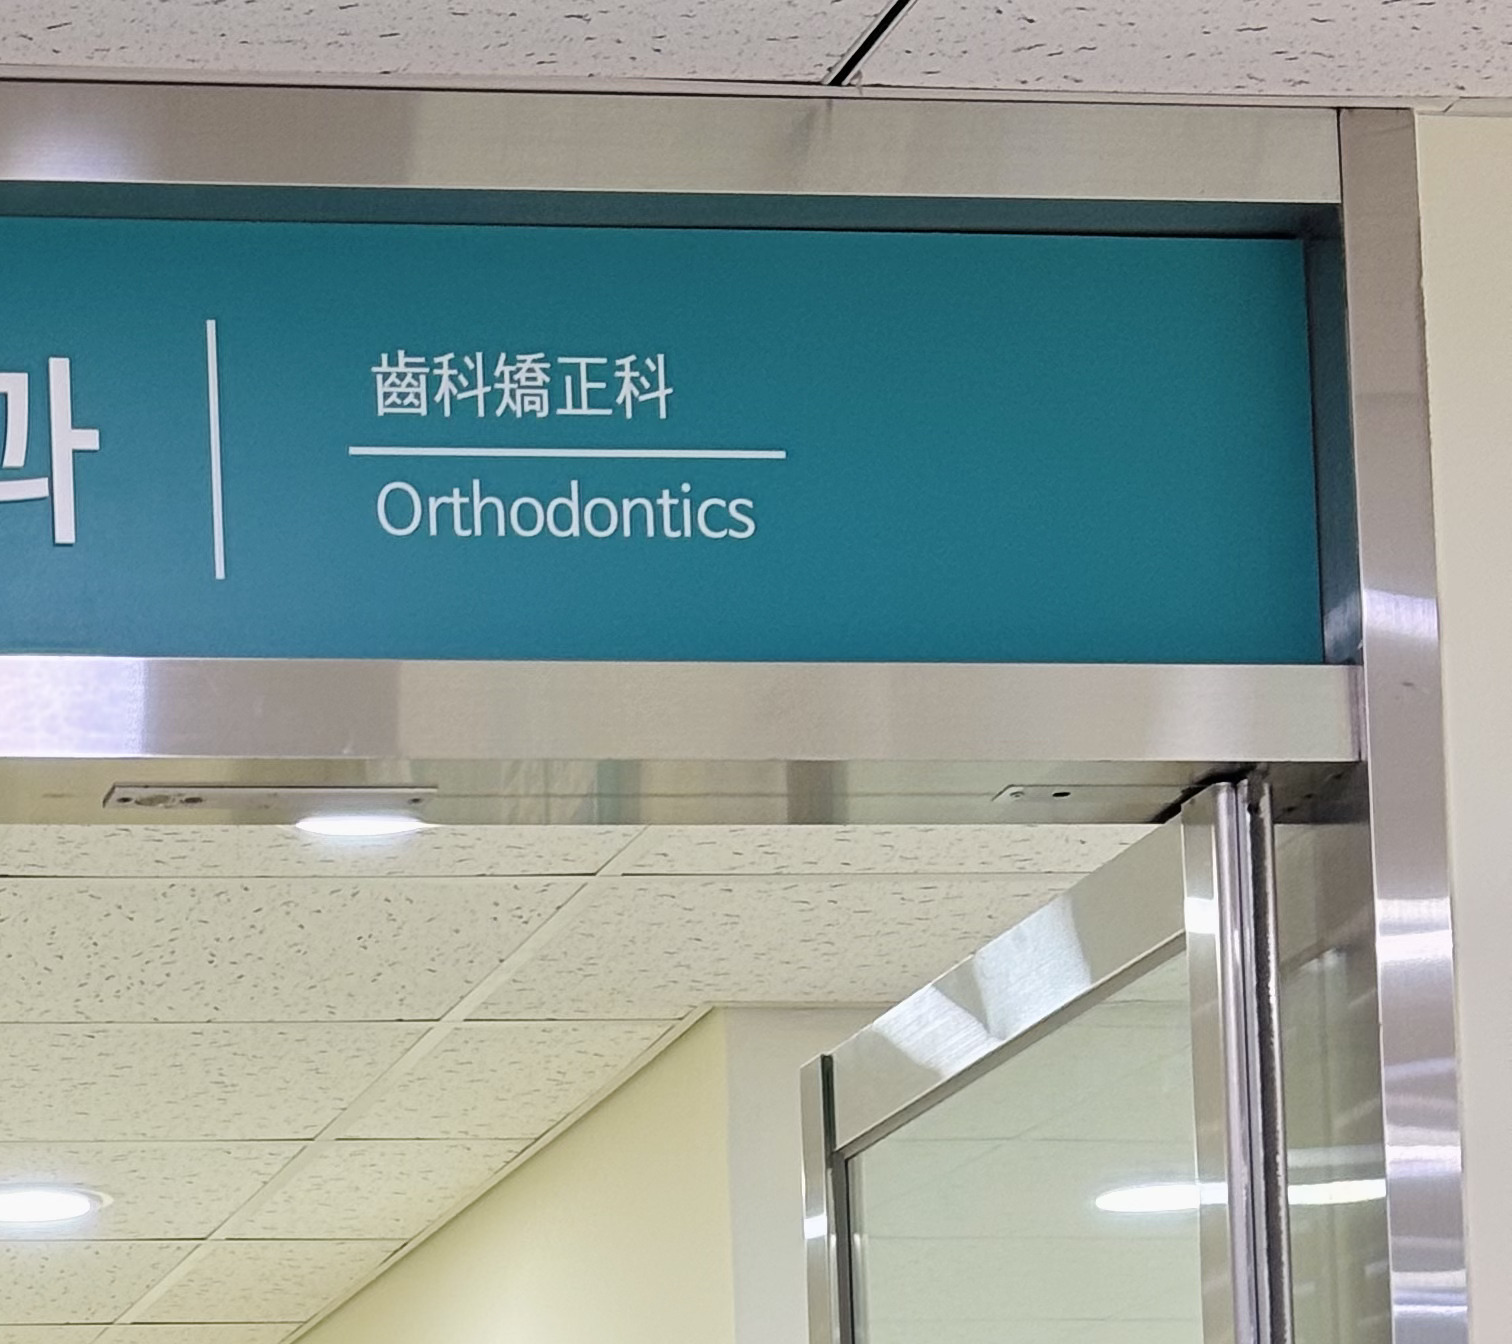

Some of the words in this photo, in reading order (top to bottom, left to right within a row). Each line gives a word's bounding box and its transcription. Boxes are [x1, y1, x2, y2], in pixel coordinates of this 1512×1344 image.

[372, 350, 673, 419] 齒科矯正科
[378, 479, 755, 538] Orthodontics
